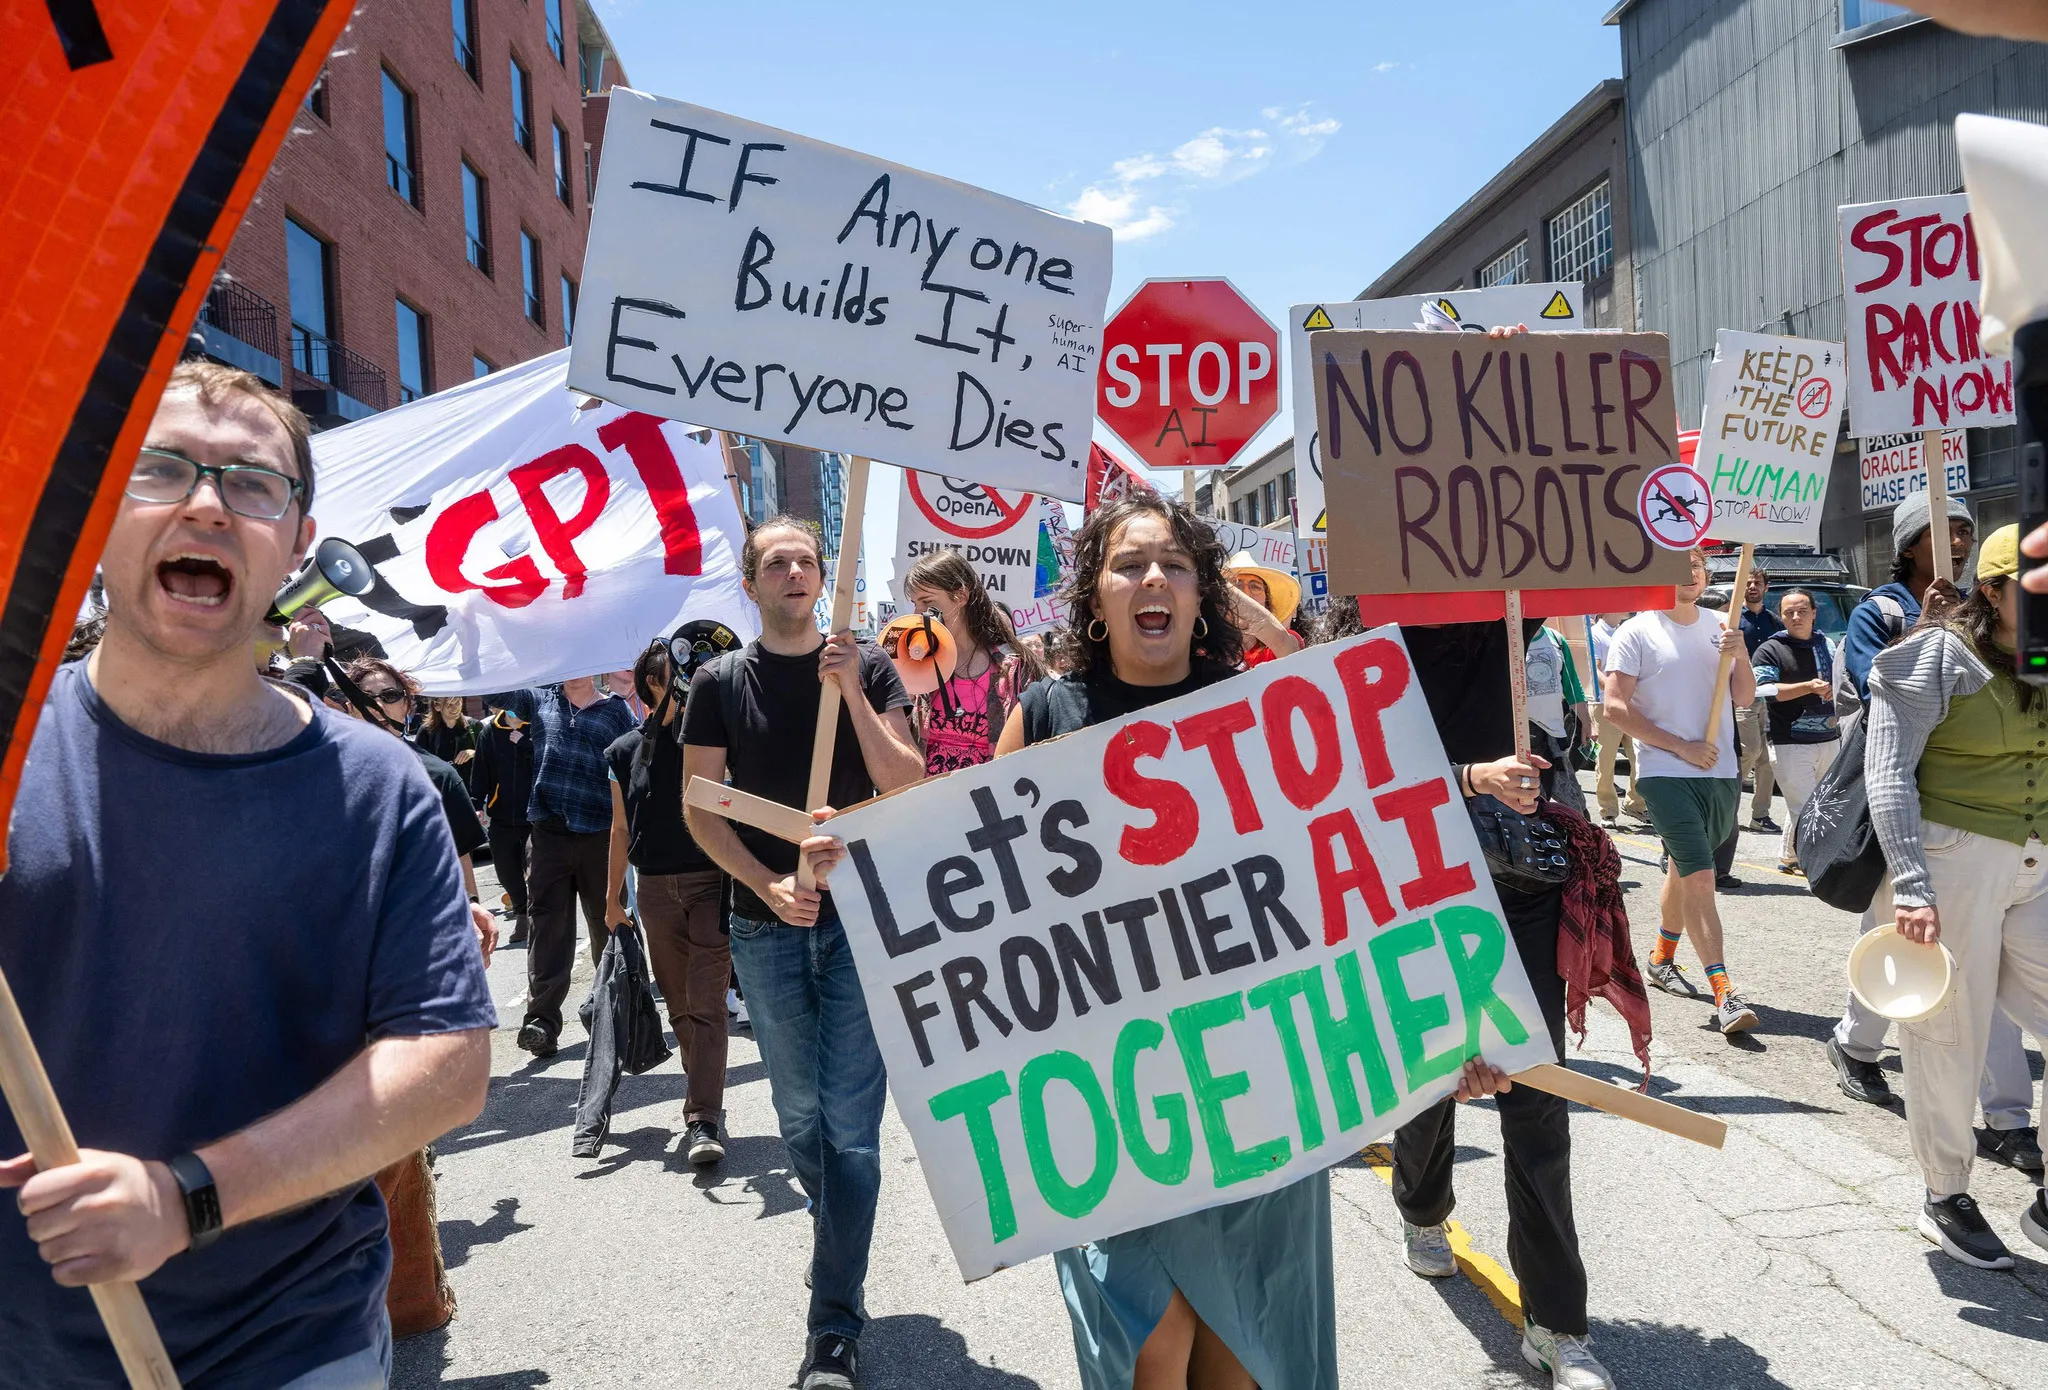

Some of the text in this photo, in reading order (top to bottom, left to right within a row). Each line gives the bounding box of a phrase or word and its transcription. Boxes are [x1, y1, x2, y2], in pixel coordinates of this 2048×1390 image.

[629, 118, 1076, 295] IF Anyone
[1851, 208, 1981, 293] STO
[734, 226, 1032, 372] Builds It,
[1052, 332, 1095, 355] human
[1057, 353, 1086, 373] AI
[605, 294, 1081, 468] Everyone Dies.
[1105, 341, 1272, 408] STOP
[1738, 349, 1814, 389] KEEP
[1325, 348, 1673, 461] NO KILLER
[1740, 385, 1795, 417] THE
[1803, 386, 1825, 405] AI
[1912, 360, 2014, 427] NOW
[1154, 407, 1218, 448] AI
[1721, 413, 1828, 457] FUTURE
[1710, 453, 1825, 503] HUMAN
[1861, 435, 1964, 480] ORACLE RK
[425, 411, 703, 608] GPT
[936, 495, 1005, 517] OpenA
[1863, 465, 1968, 507] CHASE CEER
[1395, 464, 1654, 586] ROBOTS
[1713, 500, 1811, 521] STOP AI NOW!
[966, 545, 1031, 567] DOWN
[1262, 537, 1294, 564] THE
[847, 776, 1103, 959] Let's
[1103, 636, 1412, 867] STOP
[893, 776, 1478, 1068] FRONTIER AI
[928, 904, 1531, 1245] TOGETHER
